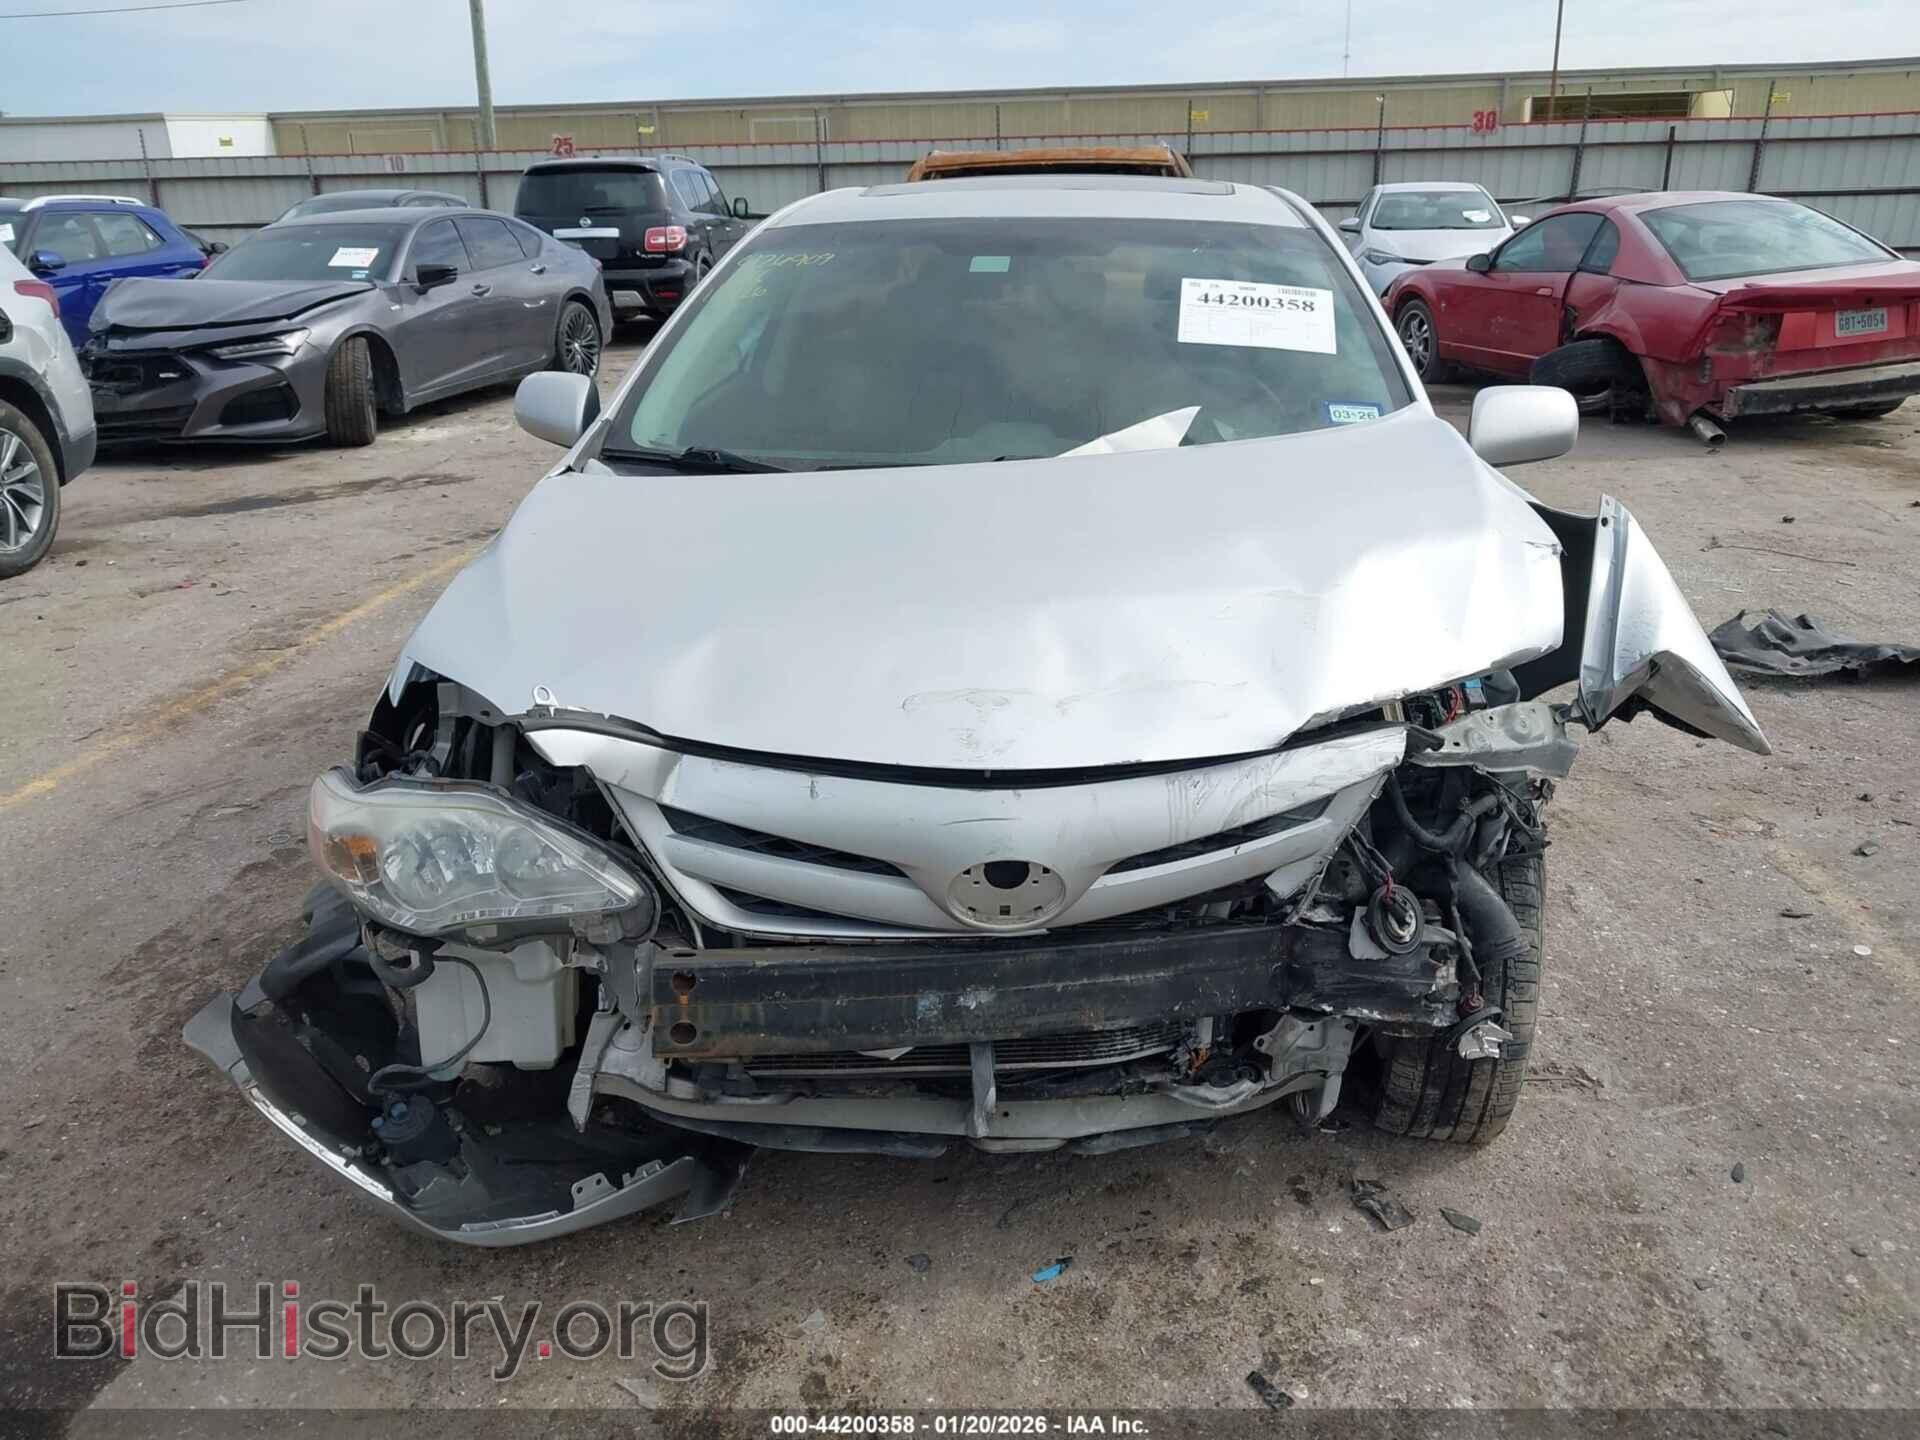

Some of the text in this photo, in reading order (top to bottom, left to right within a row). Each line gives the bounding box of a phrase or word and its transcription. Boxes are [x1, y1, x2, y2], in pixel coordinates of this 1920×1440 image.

[1473, 111, 1497, 132] 30
[554, 137, 573, 155] 25
[388, 155, 405, 171] 10
[1197, 292, 1316, 312] 44200358
